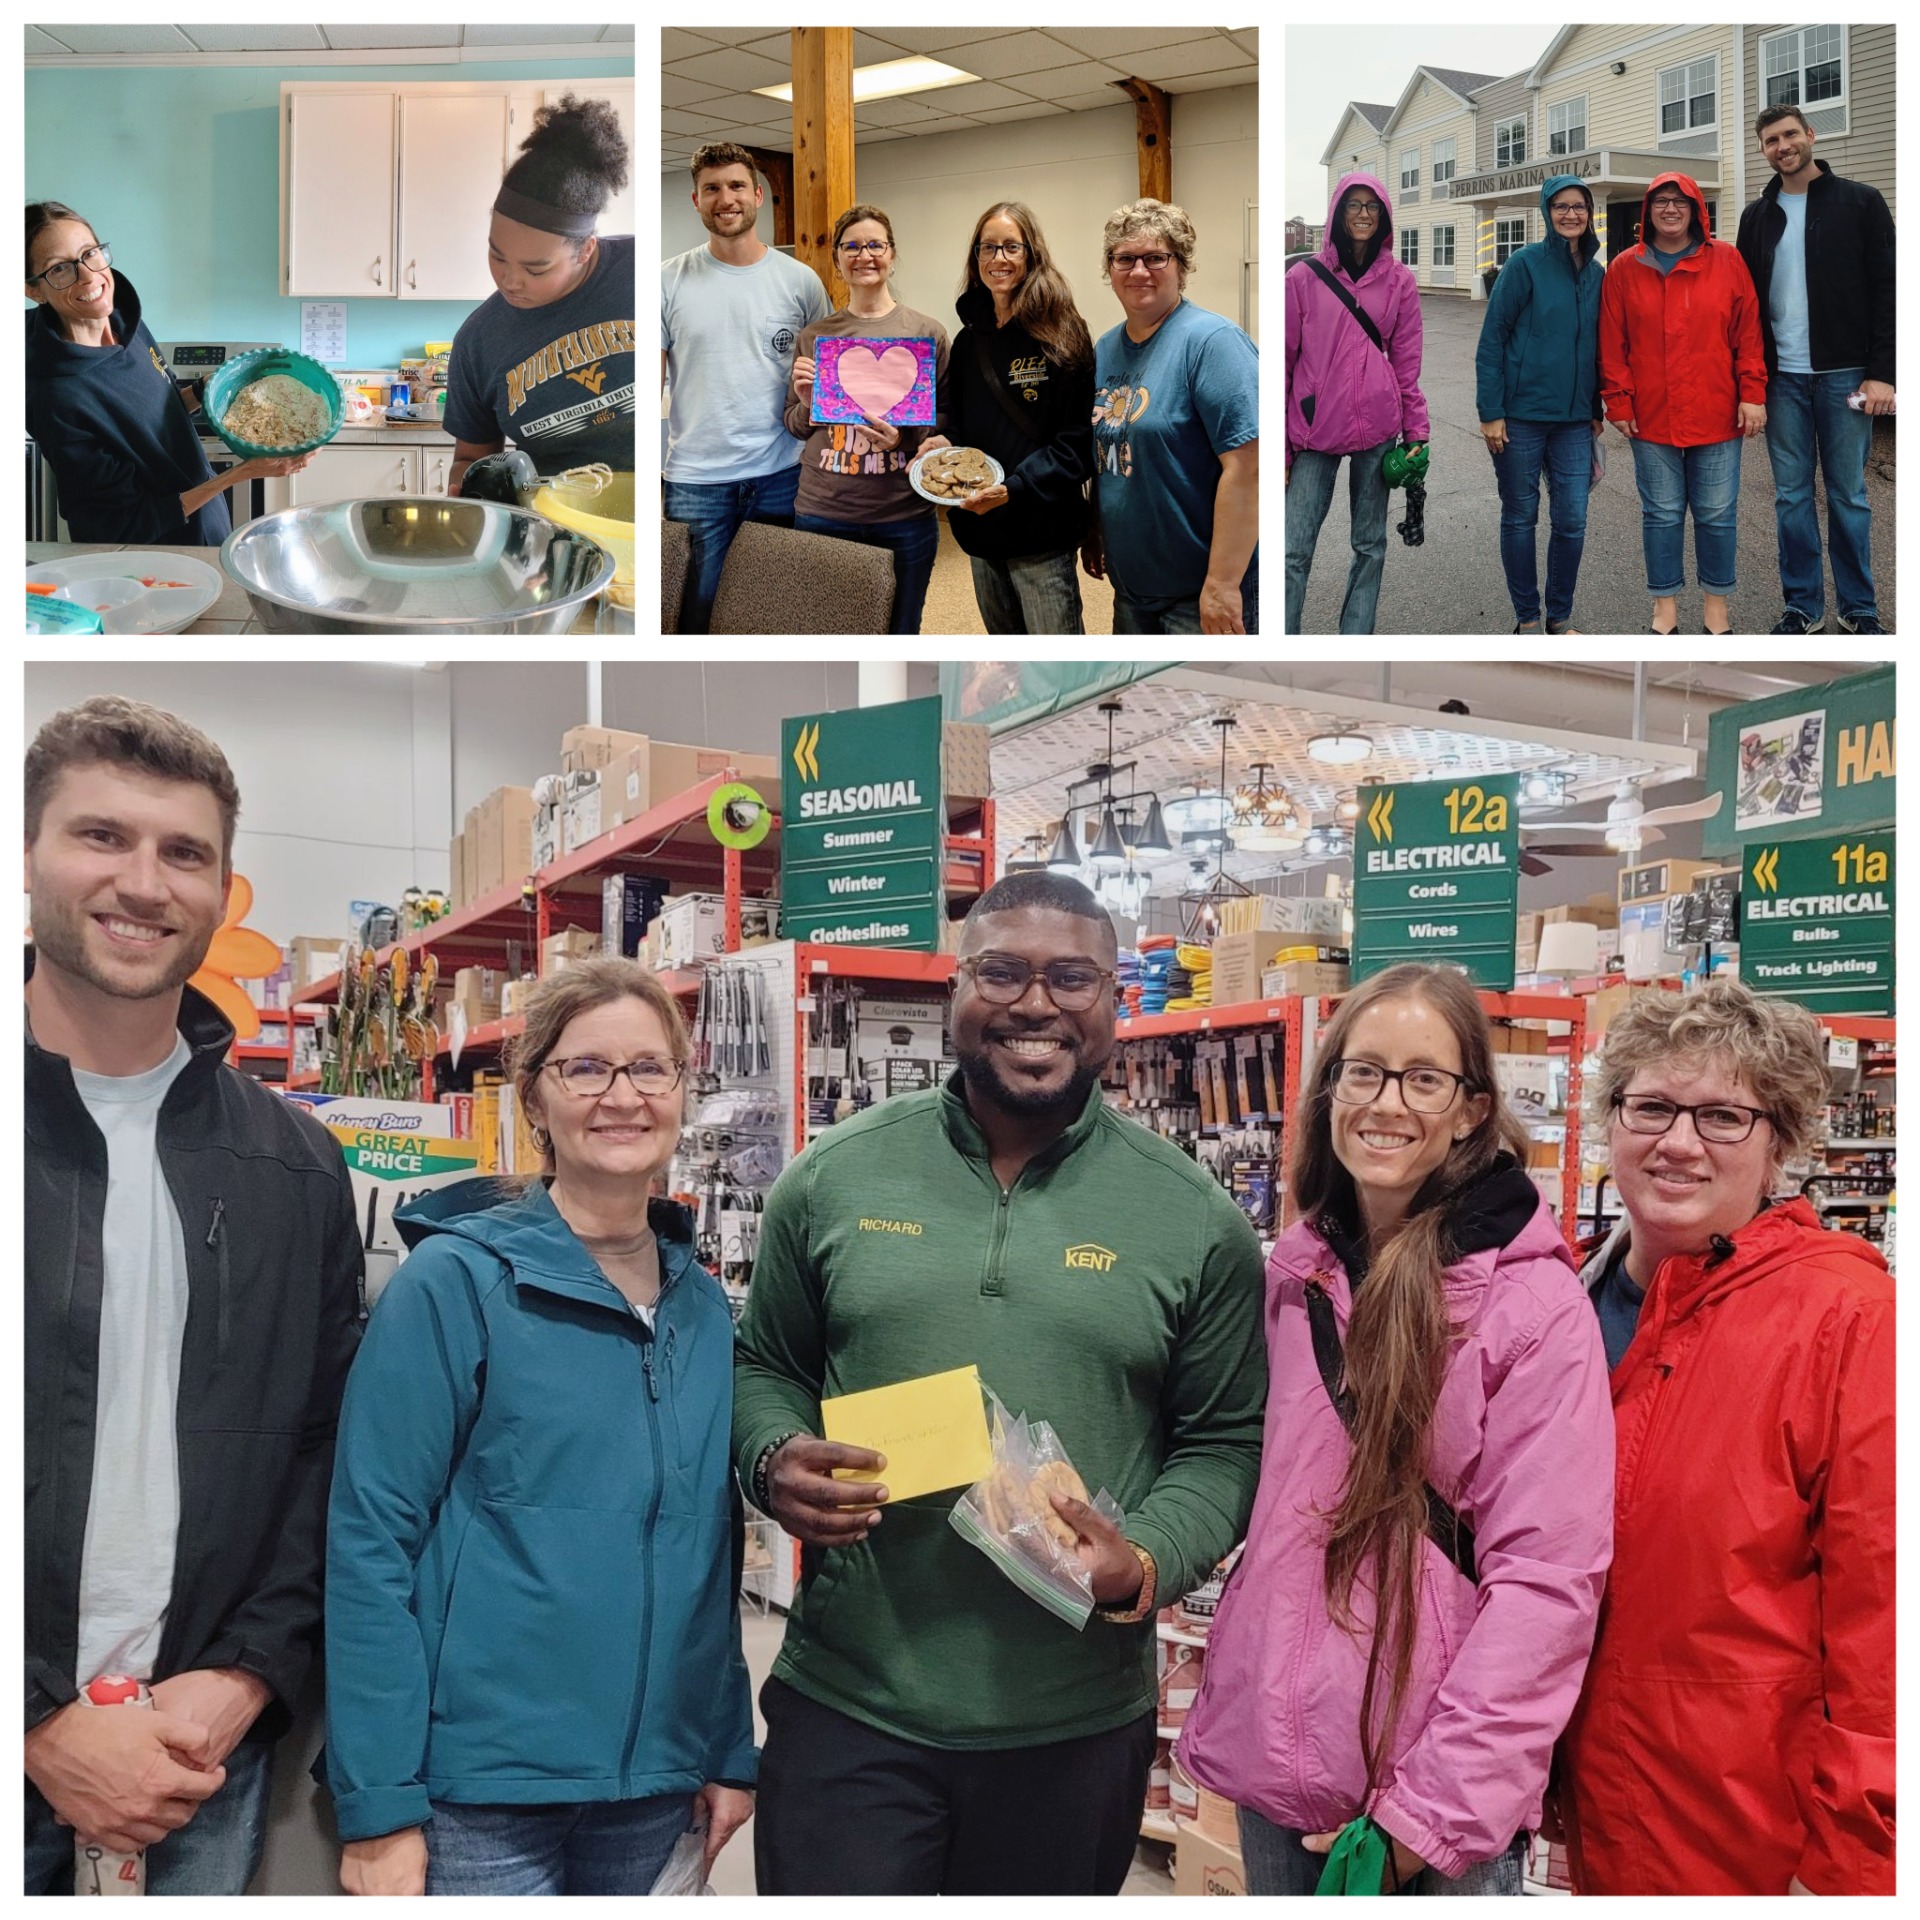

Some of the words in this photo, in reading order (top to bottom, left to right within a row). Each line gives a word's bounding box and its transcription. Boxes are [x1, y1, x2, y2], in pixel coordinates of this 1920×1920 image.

[1455, 176, 1495, 198] PERRINS
[1499, 168, 1546, 191] MARINA
[523, 417, 552, 435] WEST
[553, 400, 605, 421] VIRGINIA
[833, 424, 890, 456] BIB
[819, 448, 860, 476] TELLS
[864, 453, 886, 475] ME
[889, 450, 907, 472] SO
[1836, 717, 1896, 787] HA
[799, 779, 922, 818] SEASONAL
[1443, 785, 1508, 834] 12a
[822, 828, 895, 849] Summer
[1366, 841, 1507, 874] ELECTRICAL
[1831, 843, 1888, 885] 11a
[827, 874, 887, 895] Winter
[1408, 881, 1458, 899] Cords
[1747, 891, 1889, 920] ELECTRICAL
[809, 922, 911, 945] Clotheslines
[1408, 923, 1459, 939] Wires
[1792, 927, 1840, 942] Bulbs
[1755, 961, 1802, 977] Track
[1806, 959, 1878, 975] Lighting
[378, 1112, 422, 1130] Buns
[355, 1131, 430, 1155] GREAT
[357, 1149, 423, 1173] PRICE
[858, 1218, 923, 1236] RICHARD
[1064, 1249, 1117, 1272] KENT
